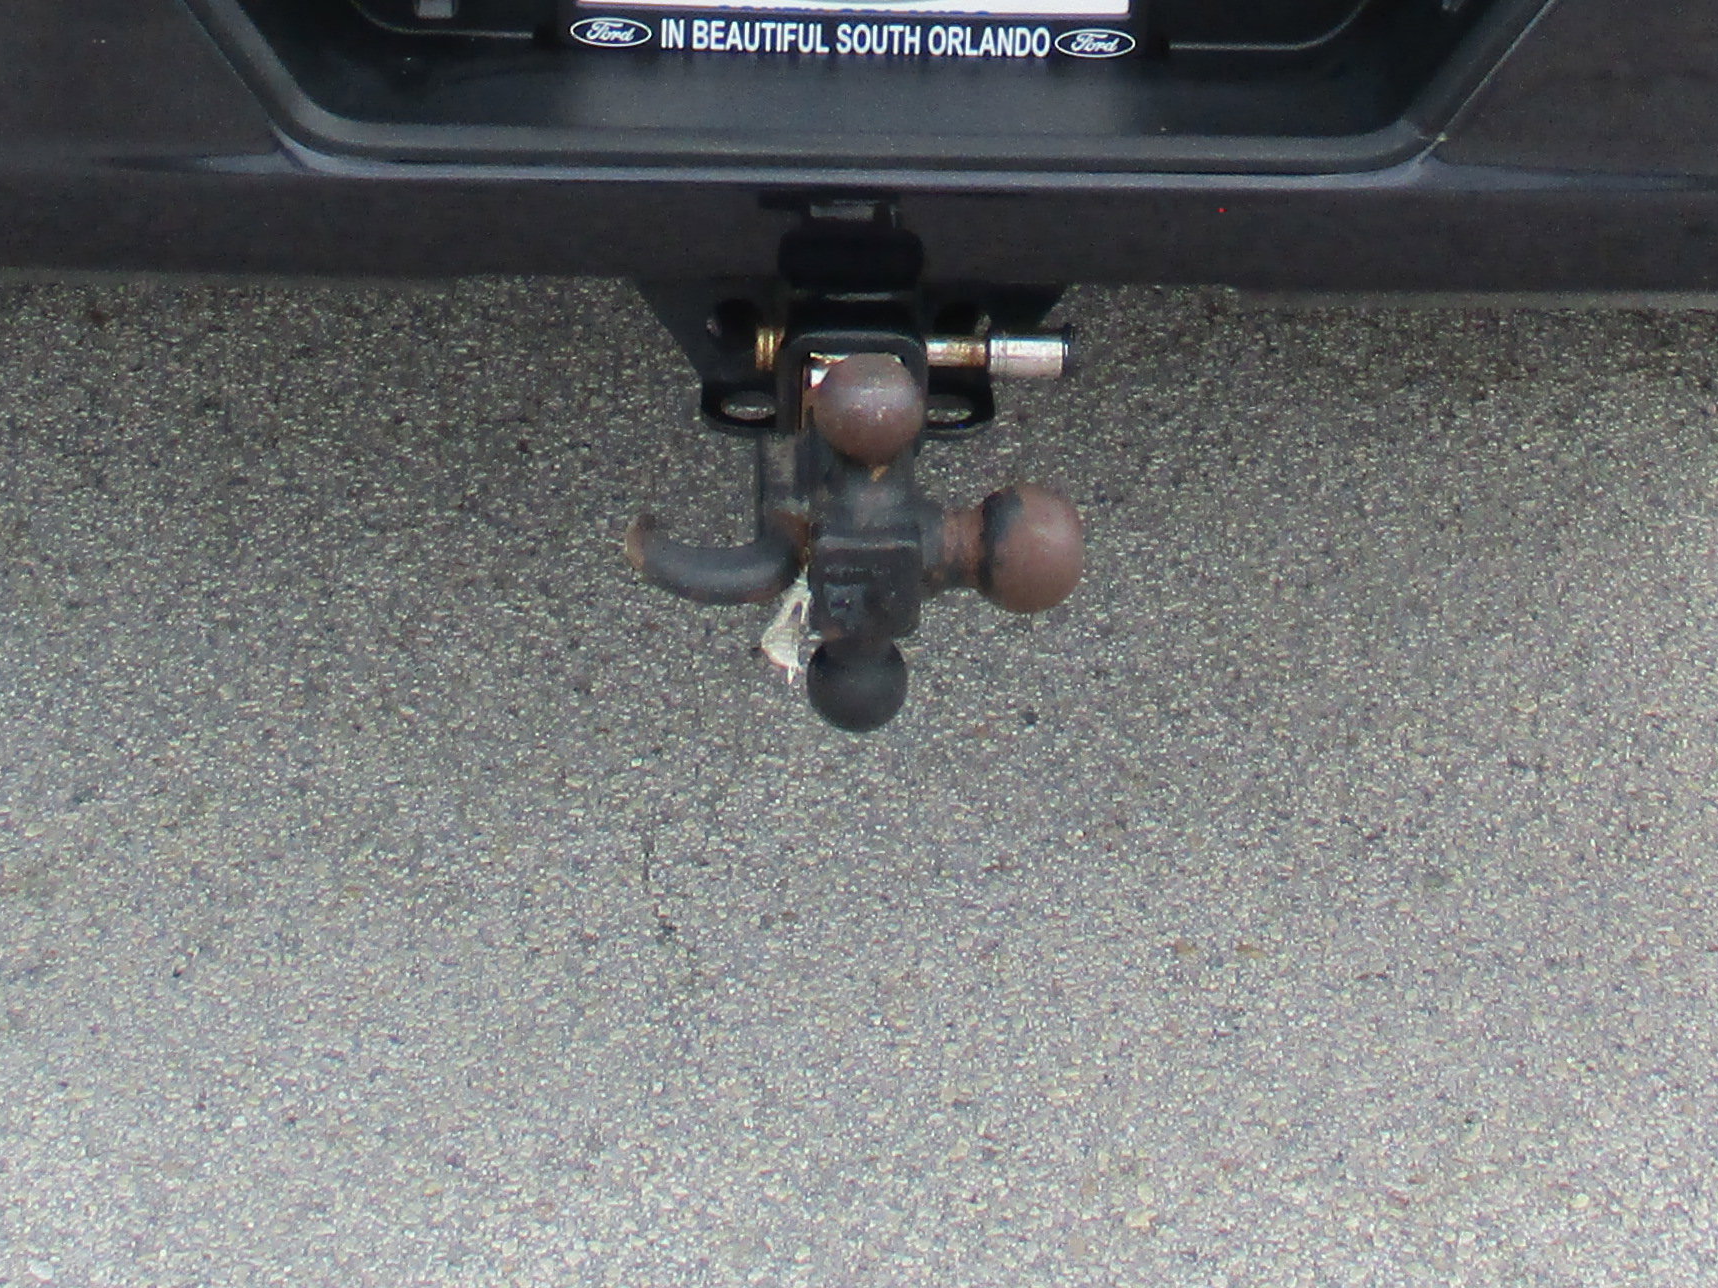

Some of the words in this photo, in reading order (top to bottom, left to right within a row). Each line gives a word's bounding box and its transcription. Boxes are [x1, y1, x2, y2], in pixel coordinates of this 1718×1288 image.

[584, 20, 636, 43] Ford
[660, 18, 684, 50] IN
[692, 20, 831, 54] BEAUTIFUL
[836, 22, 921, 56] SOUTH
[928, 24, 1052, 58] ORLANDO
[1069, 32, 1121, 54] Ford
